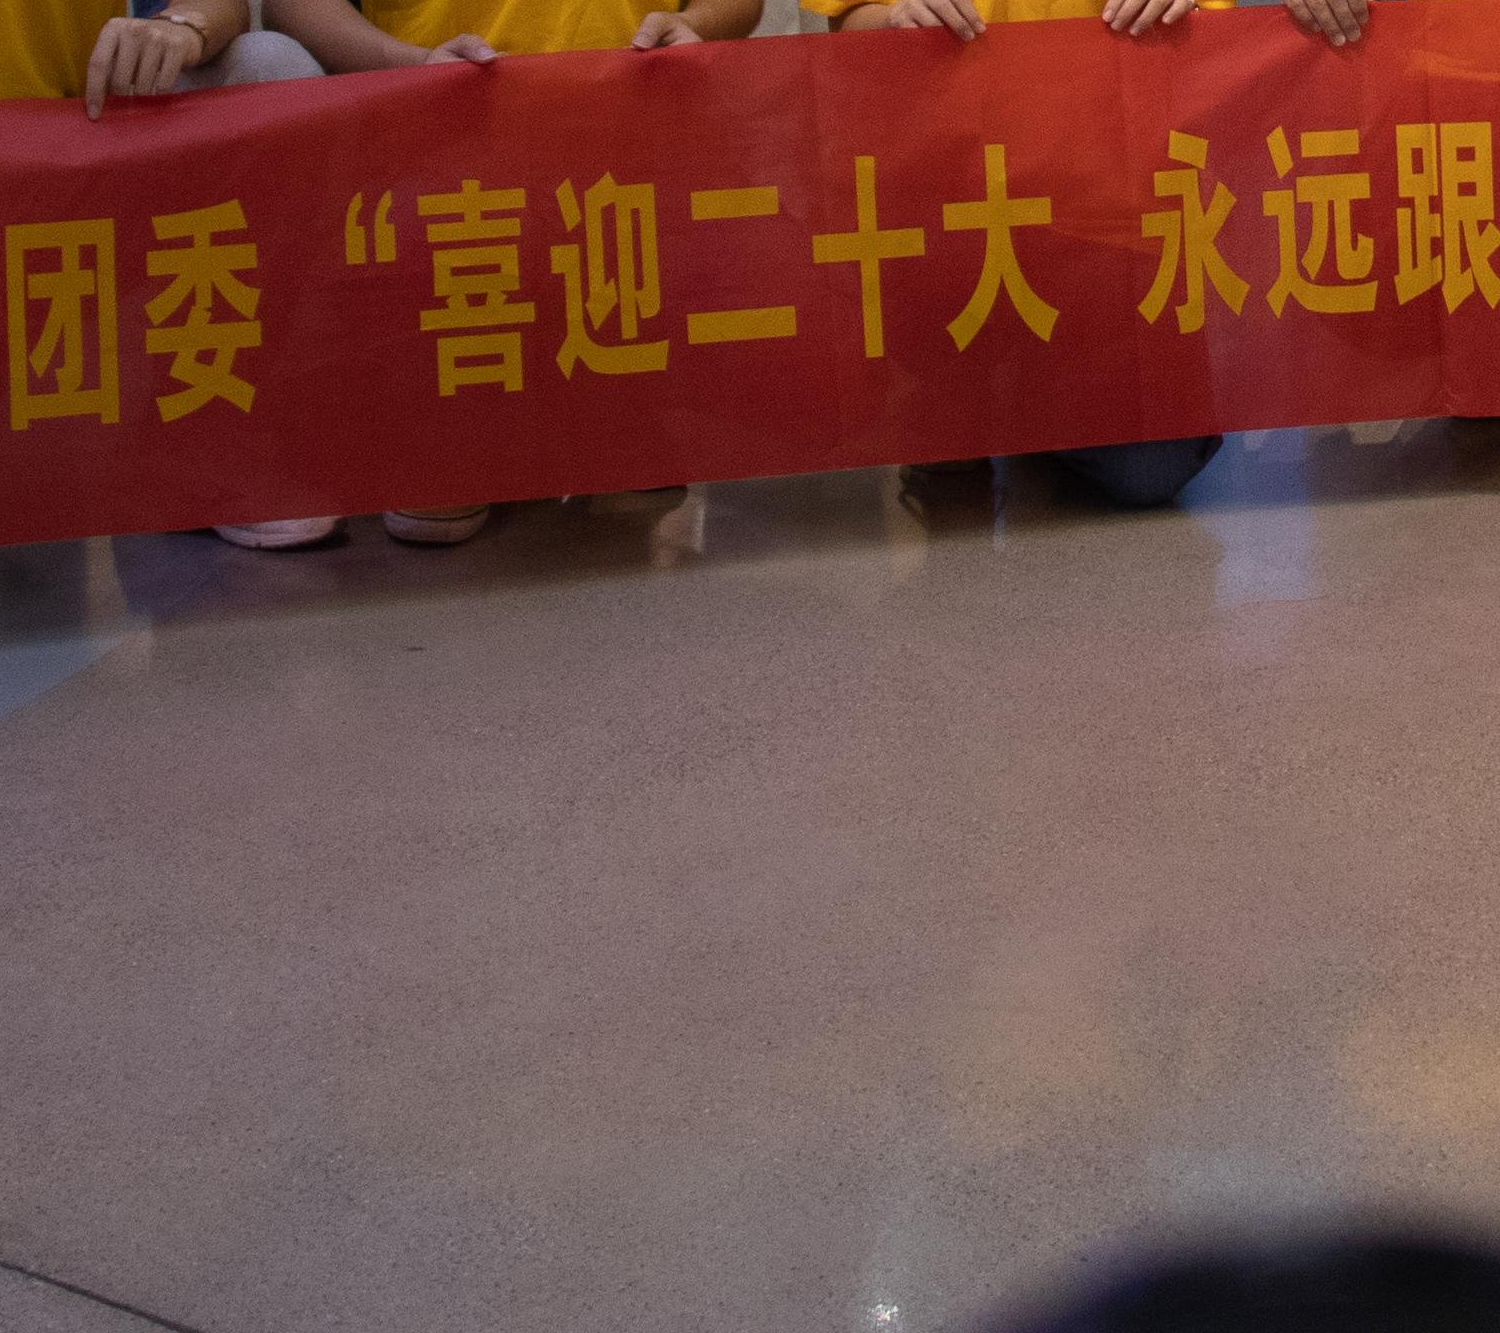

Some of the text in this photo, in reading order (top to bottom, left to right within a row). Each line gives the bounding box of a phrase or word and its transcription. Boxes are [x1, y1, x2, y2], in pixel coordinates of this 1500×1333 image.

[344, 143, 1060, 396] “喜迎二十大
